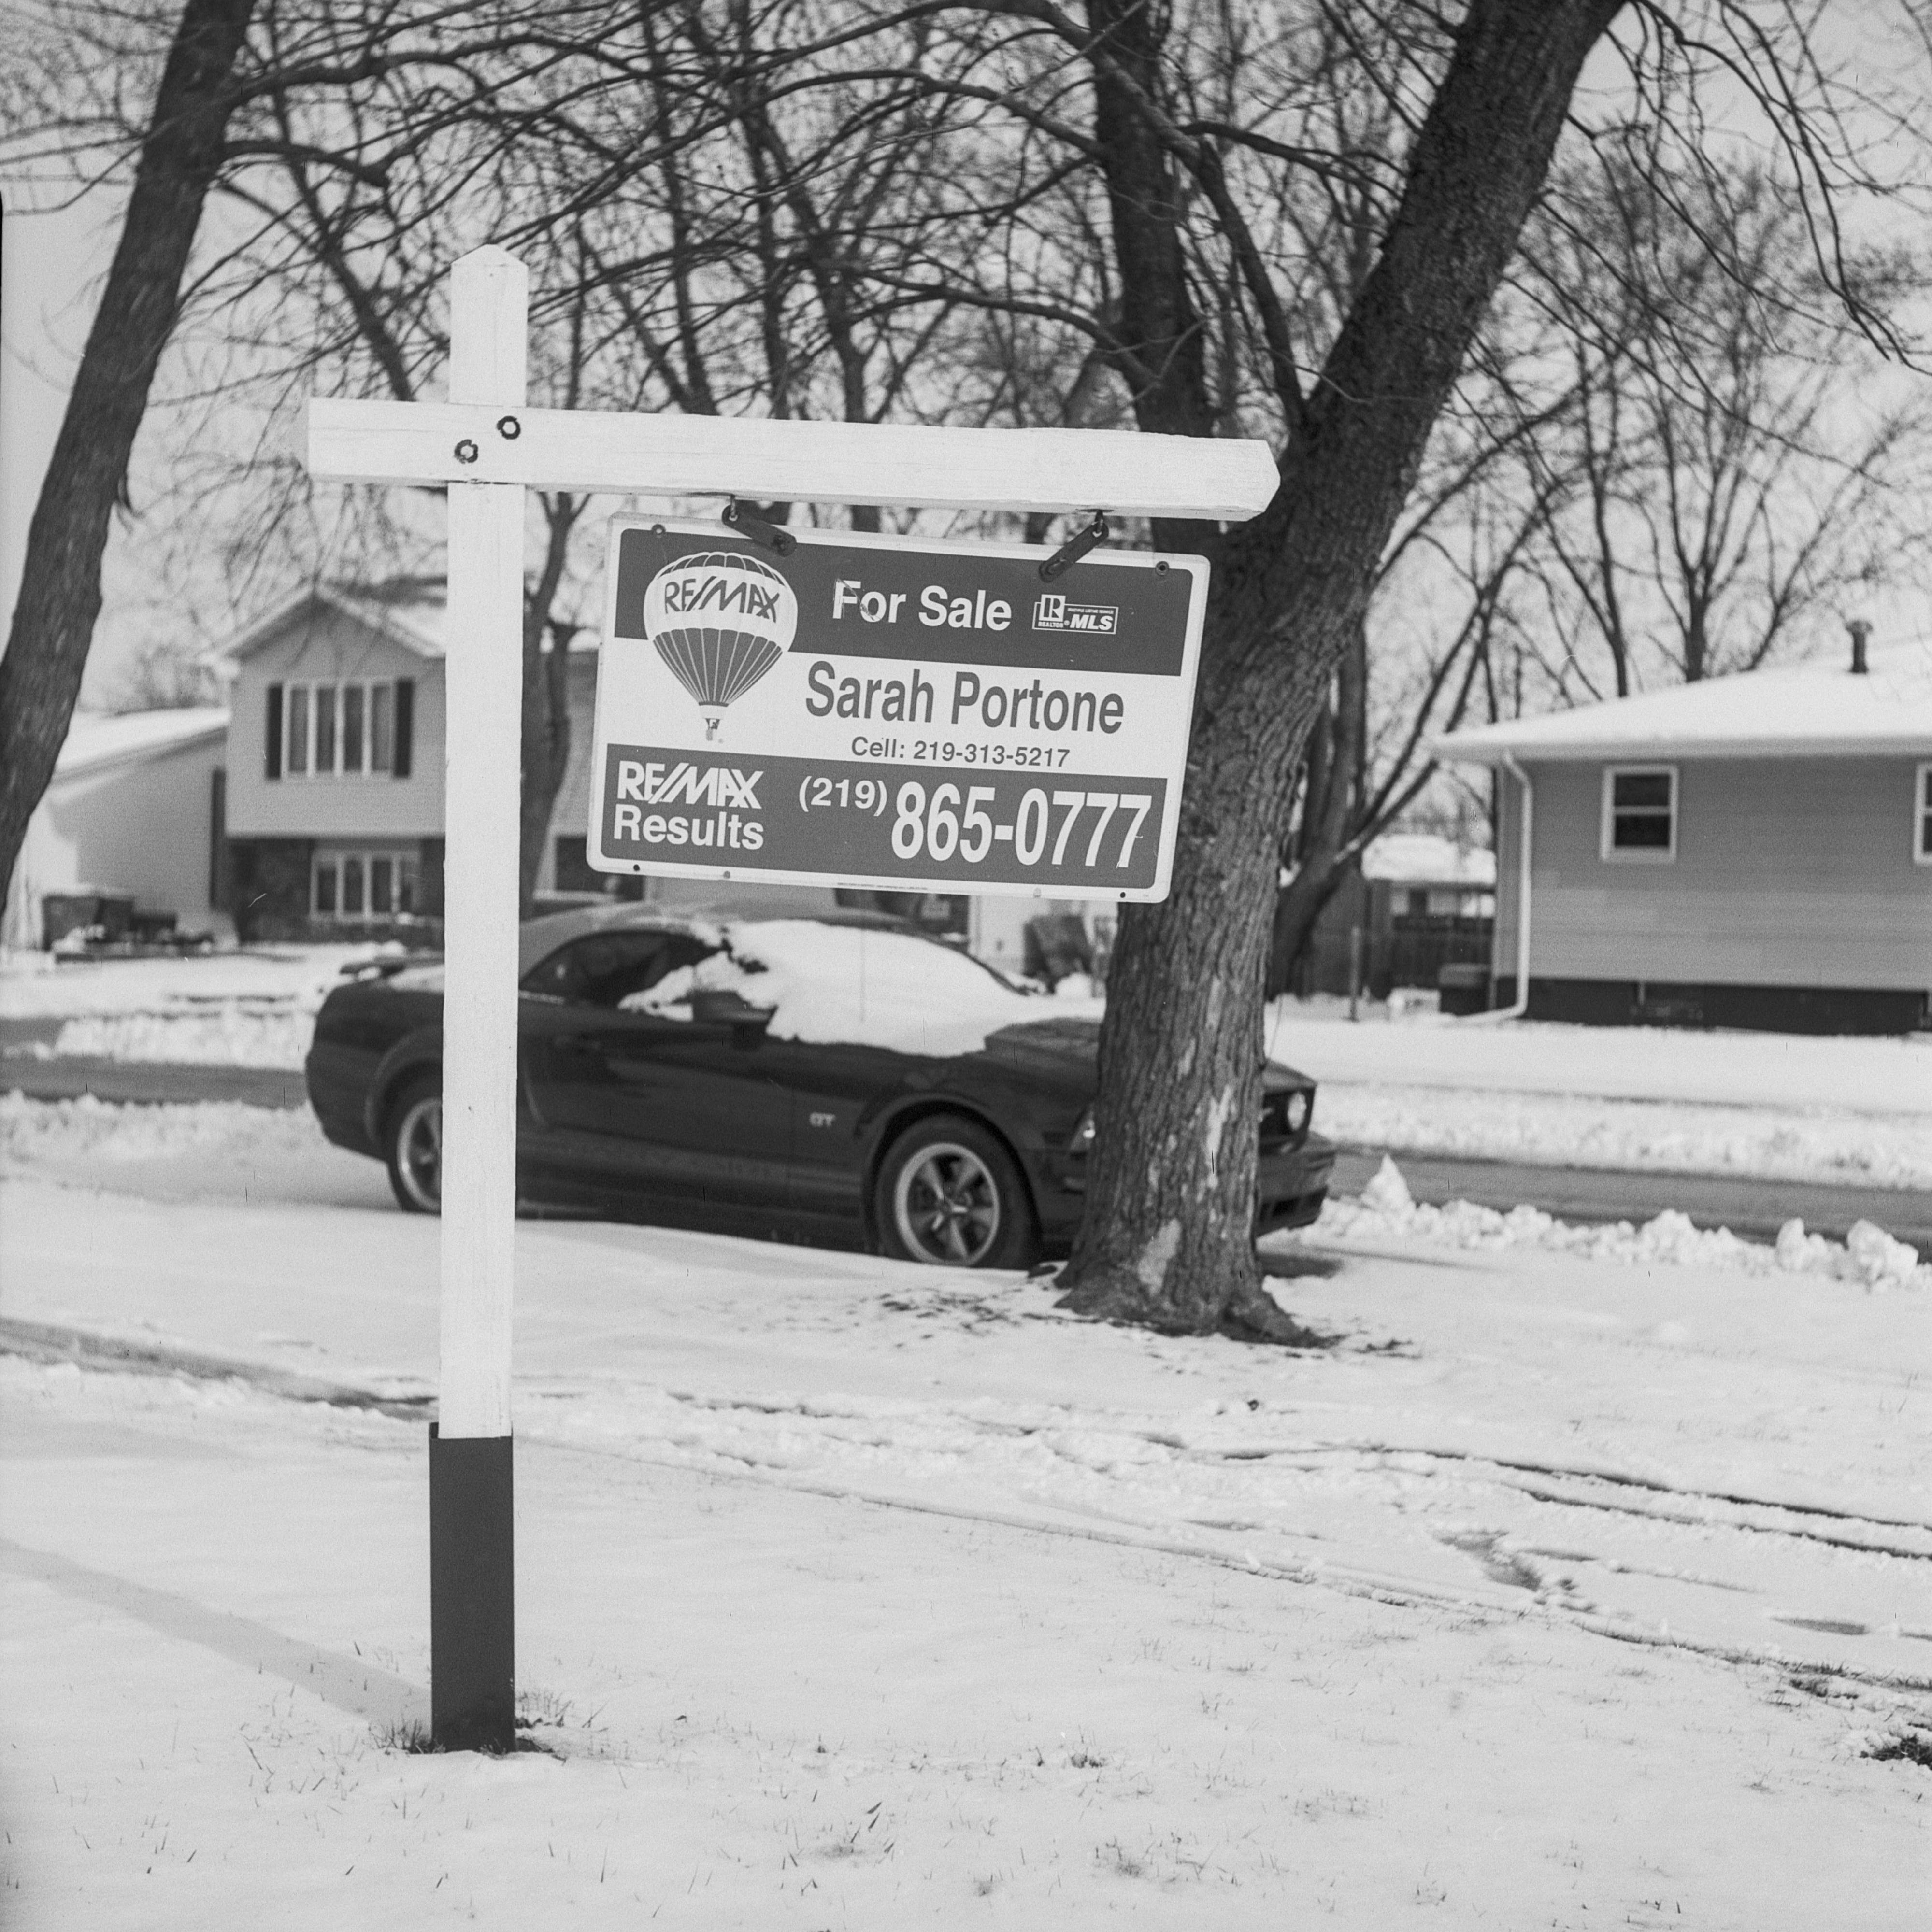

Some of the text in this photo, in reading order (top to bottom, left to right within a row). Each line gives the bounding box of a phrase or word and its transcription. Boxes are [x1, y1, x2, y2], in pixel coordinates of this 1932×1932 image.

[665, 576, 780, 623] RE/MAX
[833, 580, 1011, 630] For Sale
[1070, 614, 1113, 630] MLS
[806, 661, 1124, 734] Sarah Portone
[851, 737, 1070, 767] Cell: 219-313-5217
[616, 761, 764, 809] RE/MAX
[614, 804, 764, 850] Results
[800, 776, 1152, 868] (219) 865-0777
[809, 1112, 835, 1127] GT
